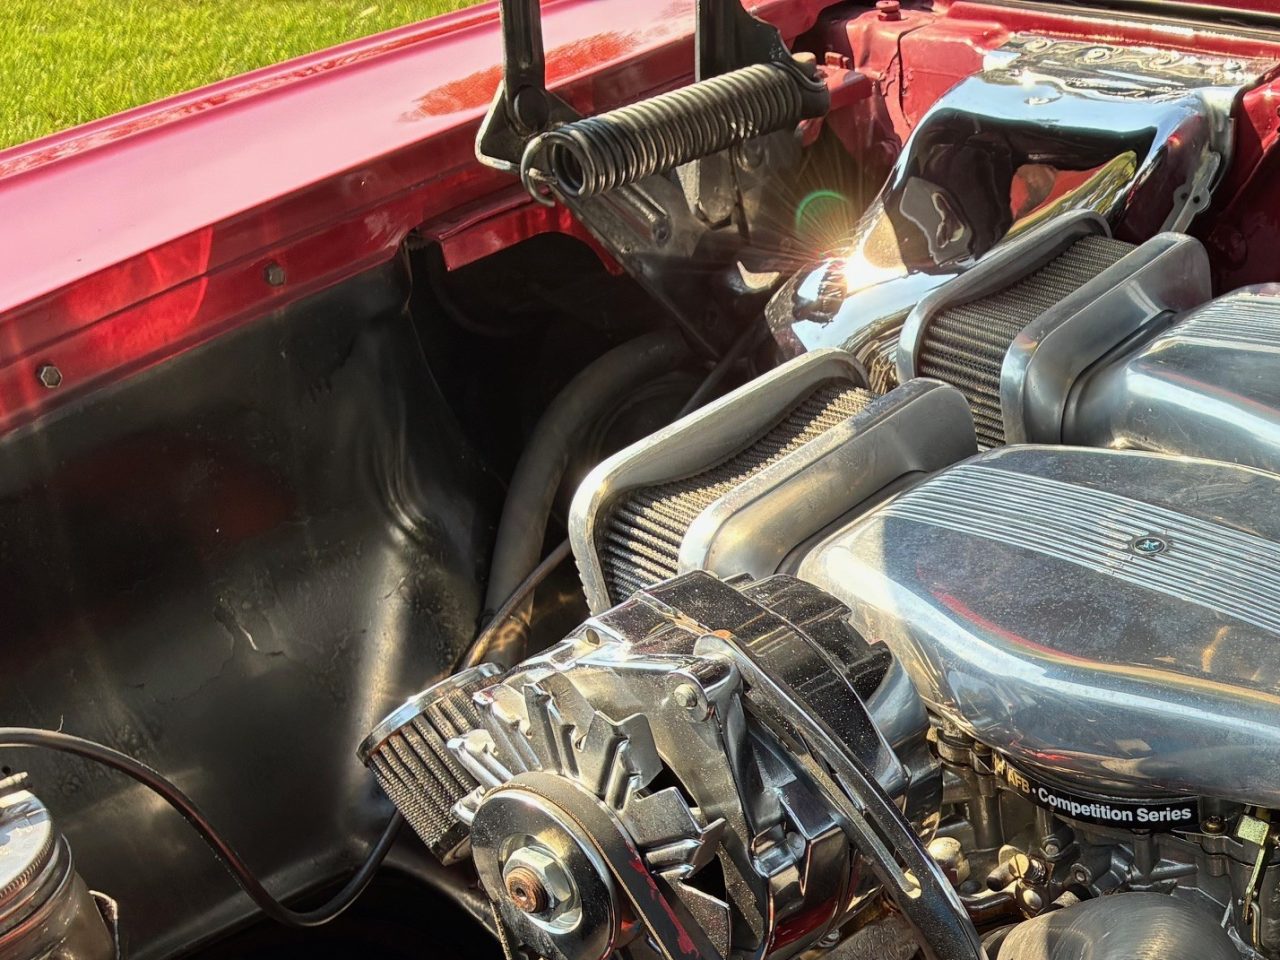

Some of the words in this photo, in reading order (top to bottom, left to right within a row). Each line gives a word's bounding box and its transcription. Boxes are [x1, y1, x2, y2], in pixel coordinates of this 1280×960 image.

[1007, 768, 1030, 794] AFB
[1037, 786, 1133, 822] Competition
[1136, 806, 1192, 823] Series
